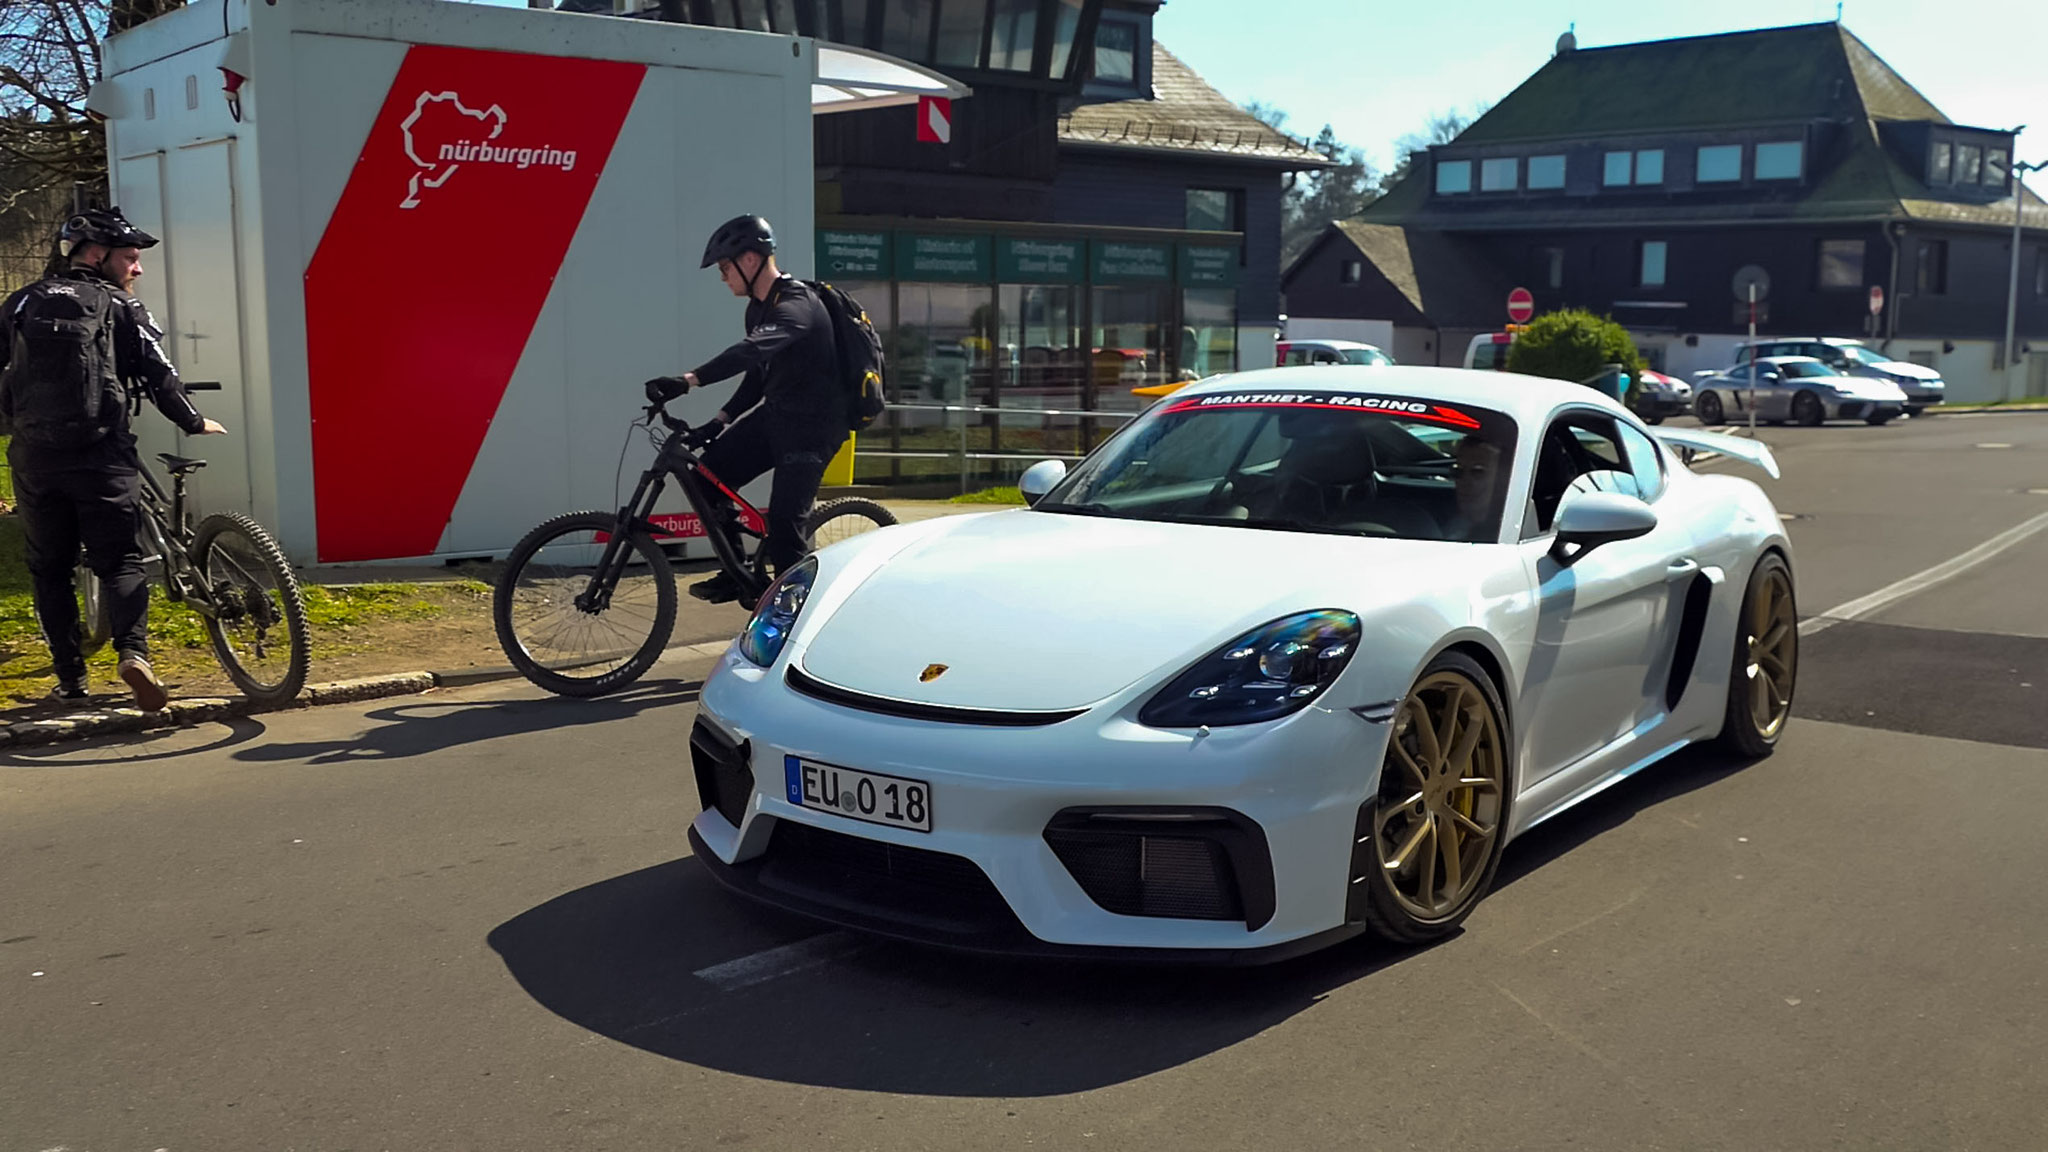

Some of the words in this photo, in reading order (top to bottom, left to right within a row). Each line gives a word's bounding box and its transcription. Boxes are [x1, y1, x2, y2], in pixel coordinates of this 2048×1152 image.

[438, 139, 577, 171] nürburgring
[1200, 394, 1312, 406] MANTHEY
[1328, 395, 1428, 413] RACING
[802, 765, 840, 808] EU
[884, 783, 926, 824] 18
